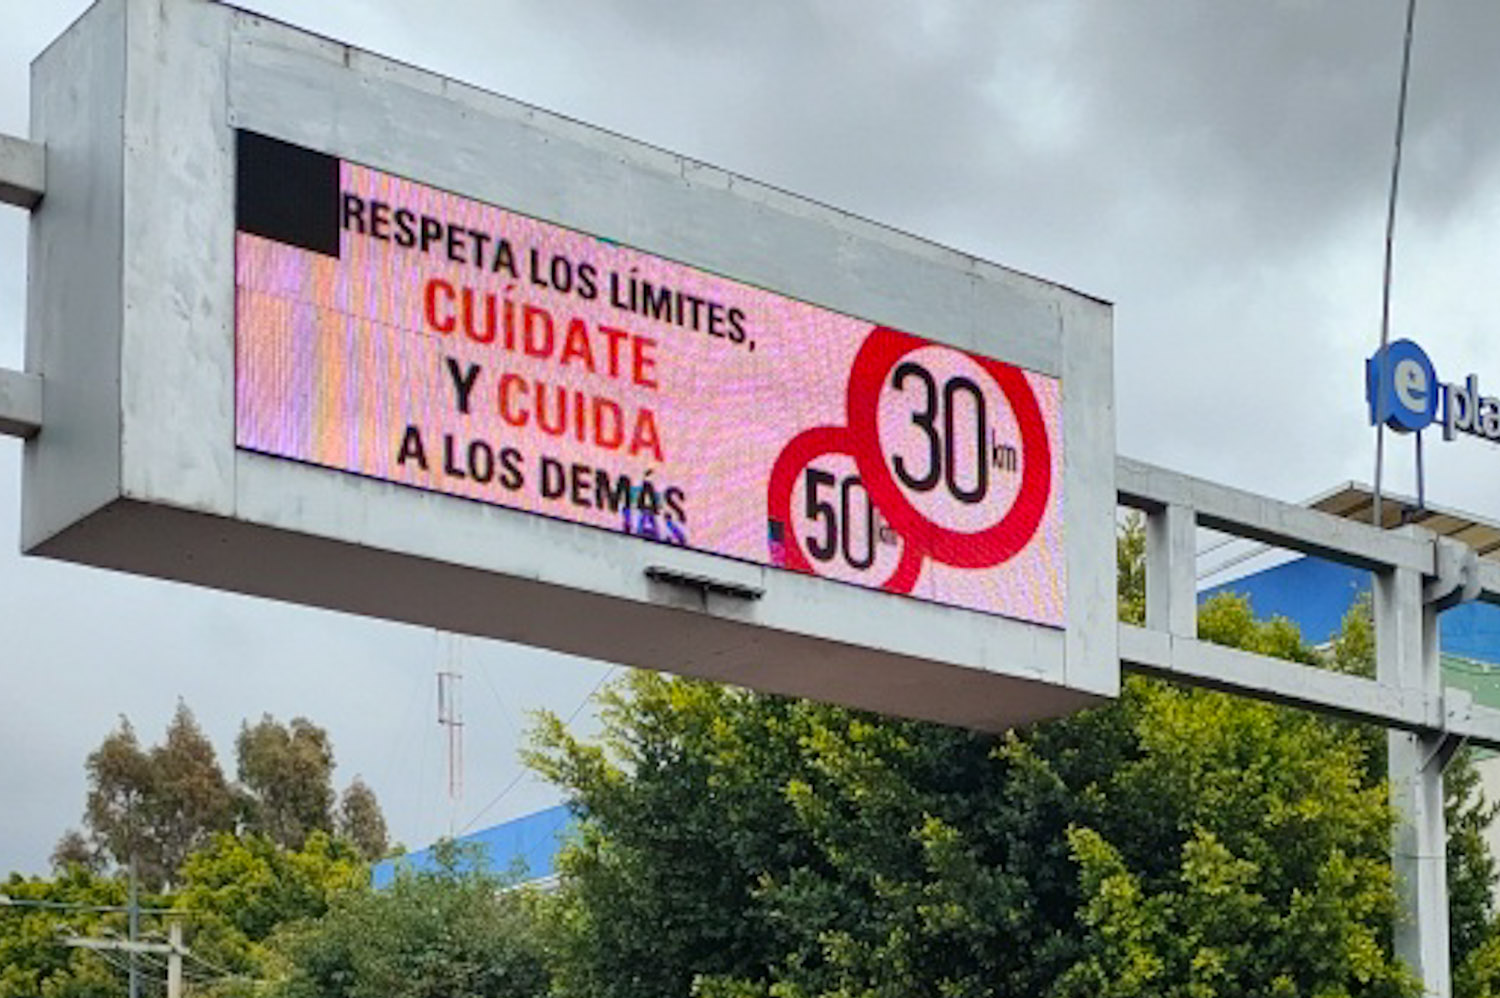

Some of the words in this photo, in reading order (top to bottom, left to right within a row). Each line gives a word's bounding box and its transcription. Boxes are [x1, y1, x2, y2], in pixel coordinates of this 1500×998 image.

[343, 191, 519, 279] RESPETA
[530, 249, 598, 300] LOS
[610, 266, 756, 352] LÍMITES,
[425, 279, 658, 390] CUÍDATE
[447, 357, 480, 414] Y
[498, 374, 664, 462] CUIDA
[892, 362, 988, 504] 30
[992, 429, 1017, 472] km
[397, 425, 428, 470] A
[444, 435, 525, 491] LOS
[540, 456, 686, 524] DEMÁS
[806, 468, 875, 570] 50
